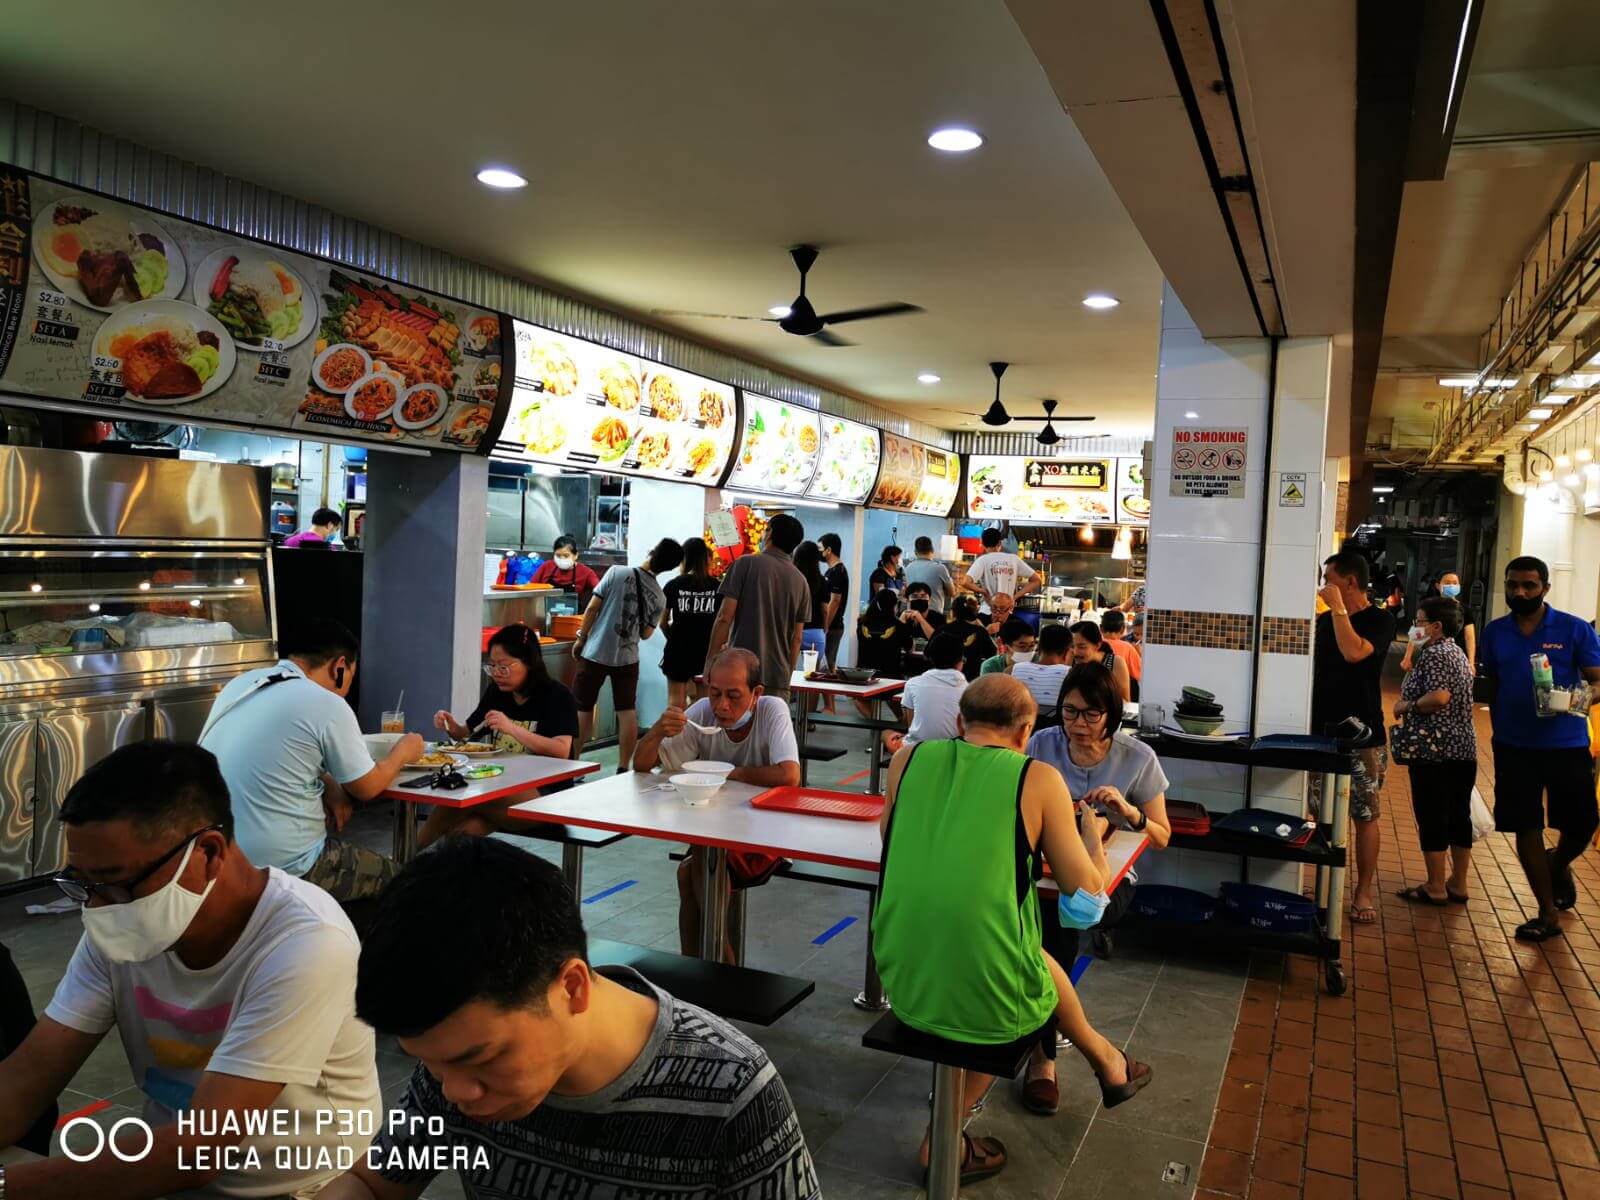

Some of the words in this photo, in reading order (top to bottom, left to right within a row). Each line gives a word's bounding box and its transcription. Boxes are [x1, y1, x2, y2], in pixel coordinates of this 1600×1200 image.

[38, 322, 56, 335] SET
[1175, 431, 1190, 442] NO
[1193, 431, 1246, 443] SMOKING
